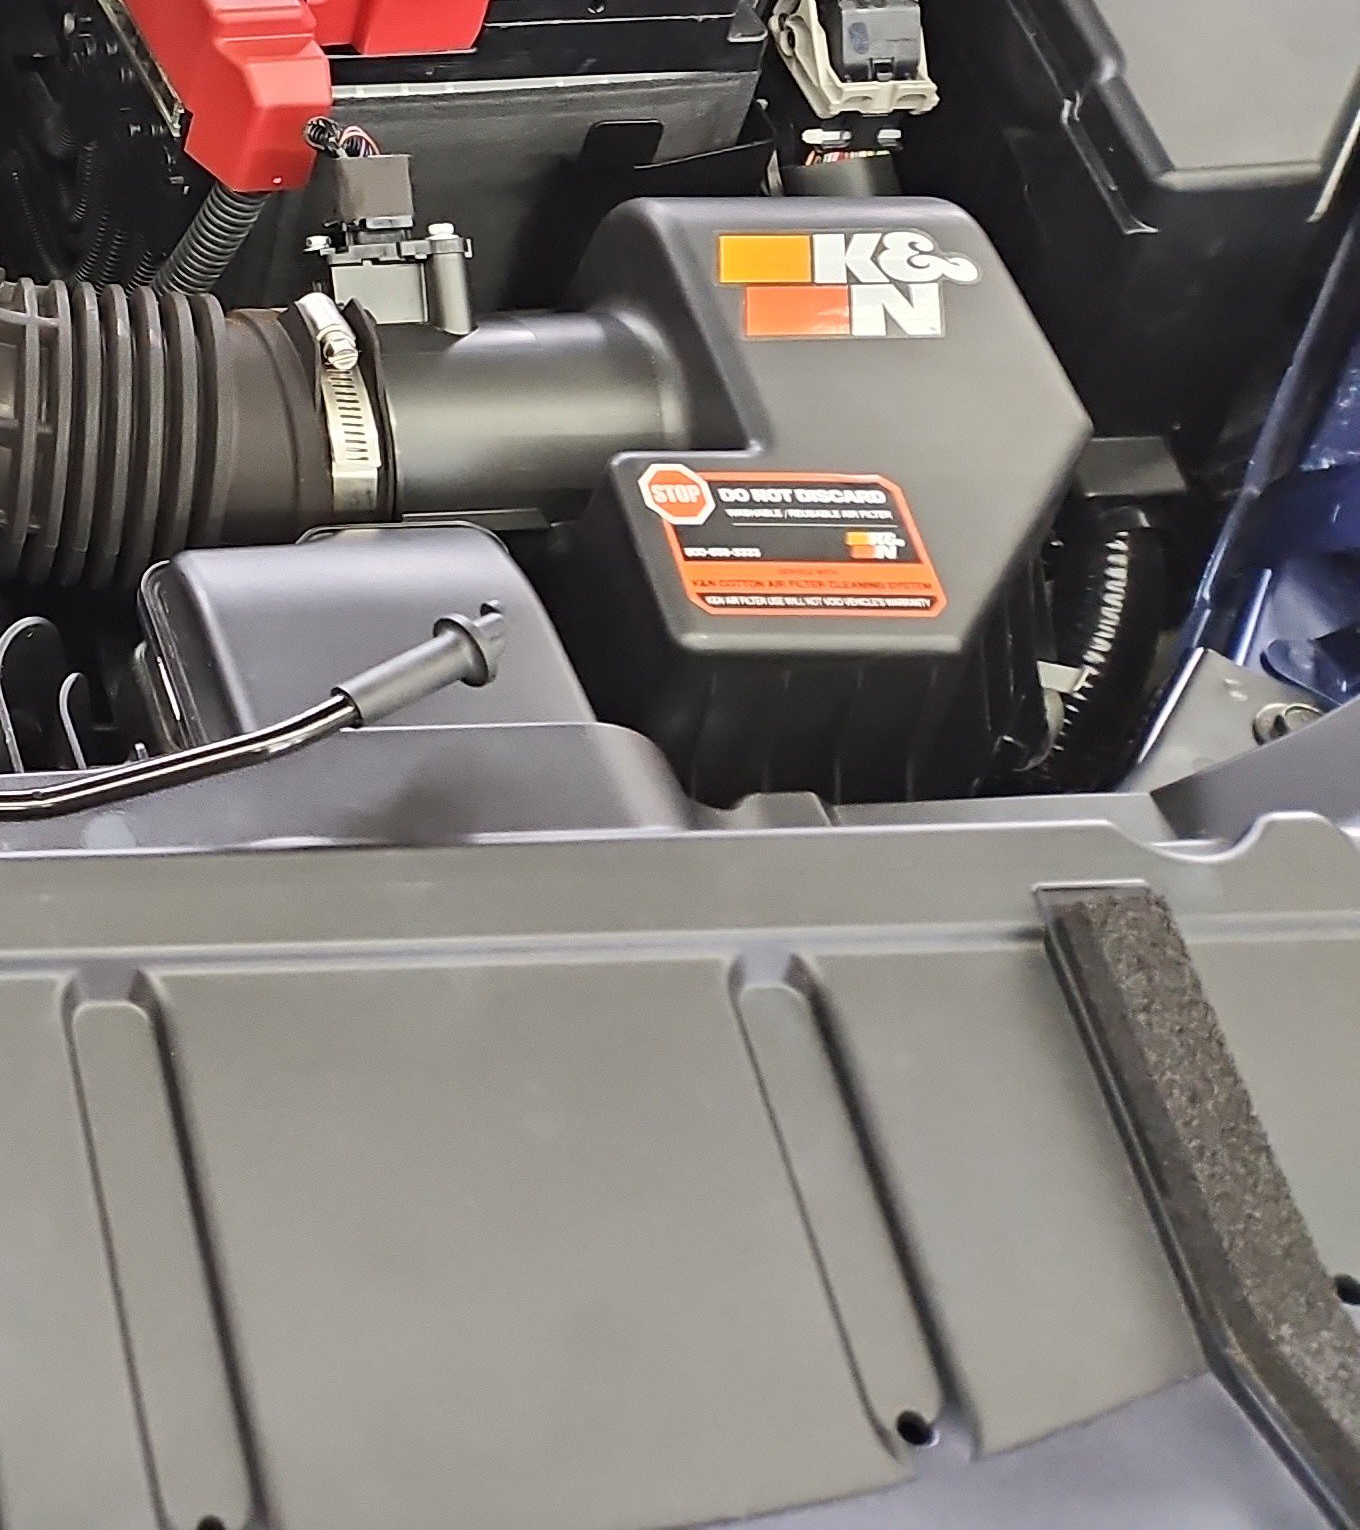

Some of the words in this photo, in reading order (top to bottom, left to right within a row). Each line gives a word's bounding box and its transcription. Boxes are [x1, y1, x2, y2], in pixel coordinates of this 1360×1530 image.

[650, 483, 701, 504] STOP
[717, 488, 750, 503] DO
[750, 488, 794, 503] NOT
[794, 489, 887, 505] DISCARD
